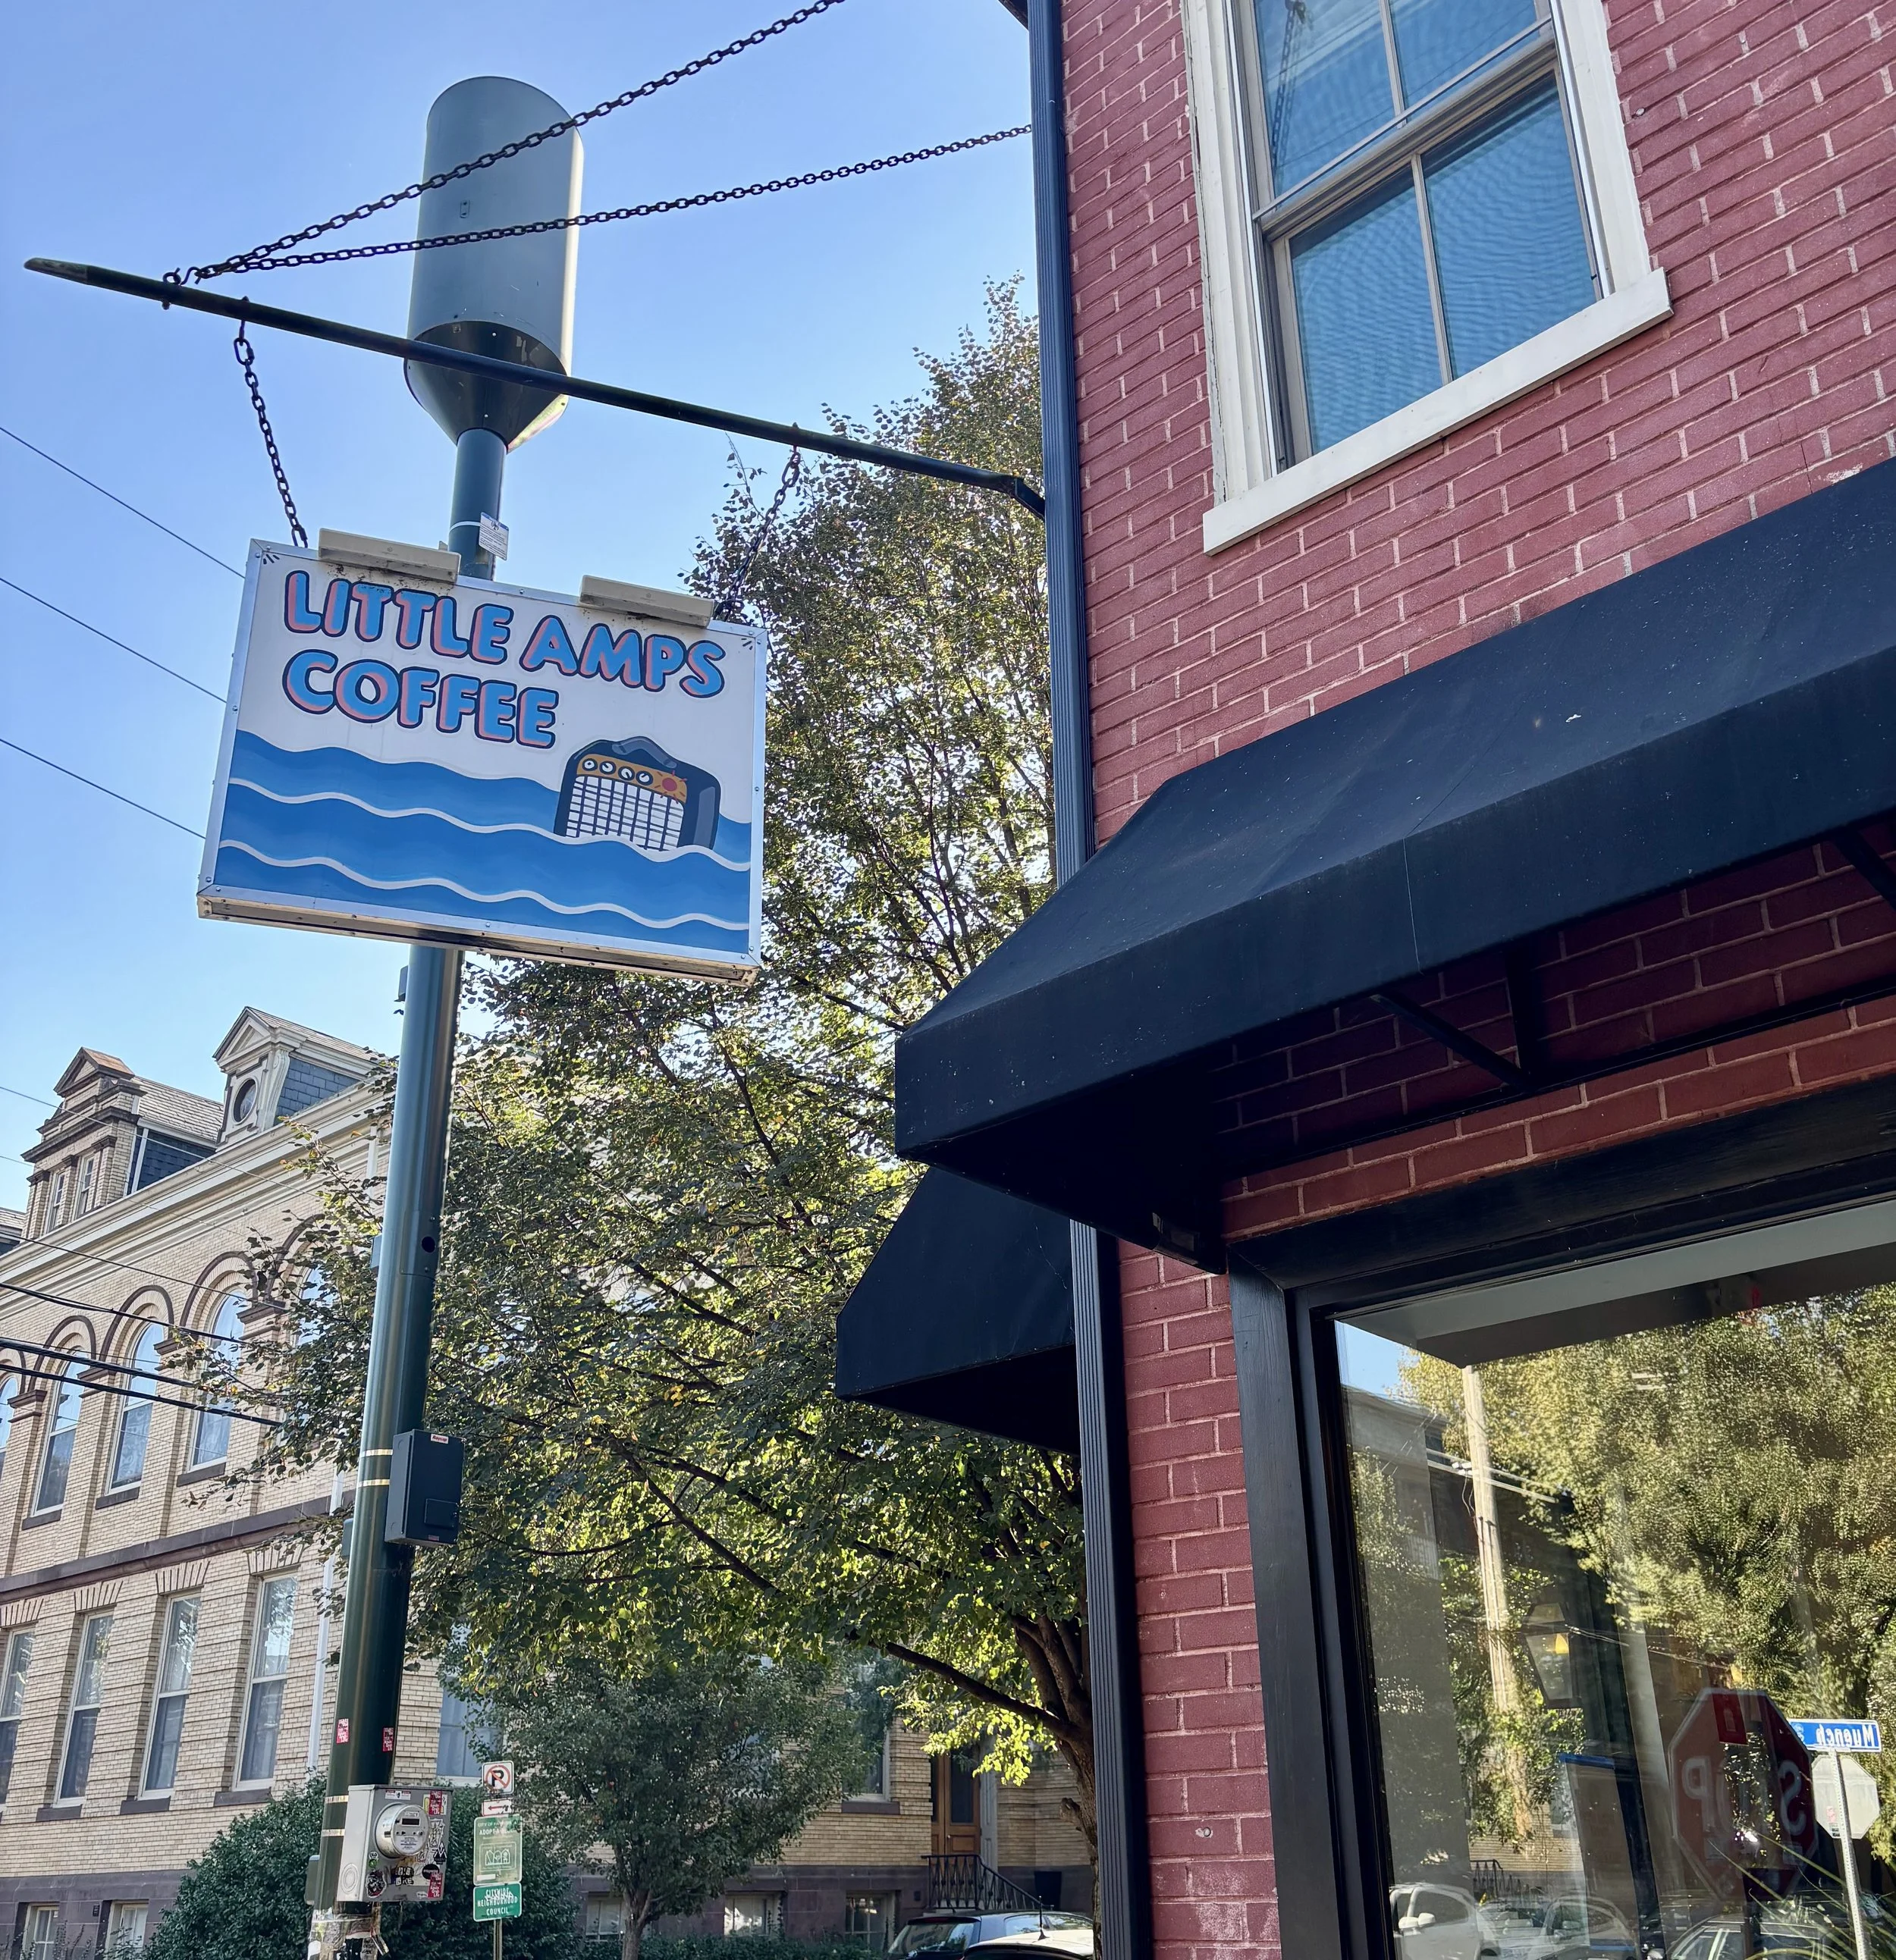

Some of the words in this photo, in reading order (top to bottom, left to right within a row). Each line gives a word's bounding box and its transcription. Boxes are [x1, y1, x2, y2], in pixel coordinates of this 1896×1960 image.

[284, 570, 513, 665] LITTLE
[520, 614, 726, 698] AMPS
[282, 649, 560, 749] COFFEE
[477, 1896, 518, 1907] NEIGHBORHOOD
[486, 1907, 509, 1915] COUNCIL
